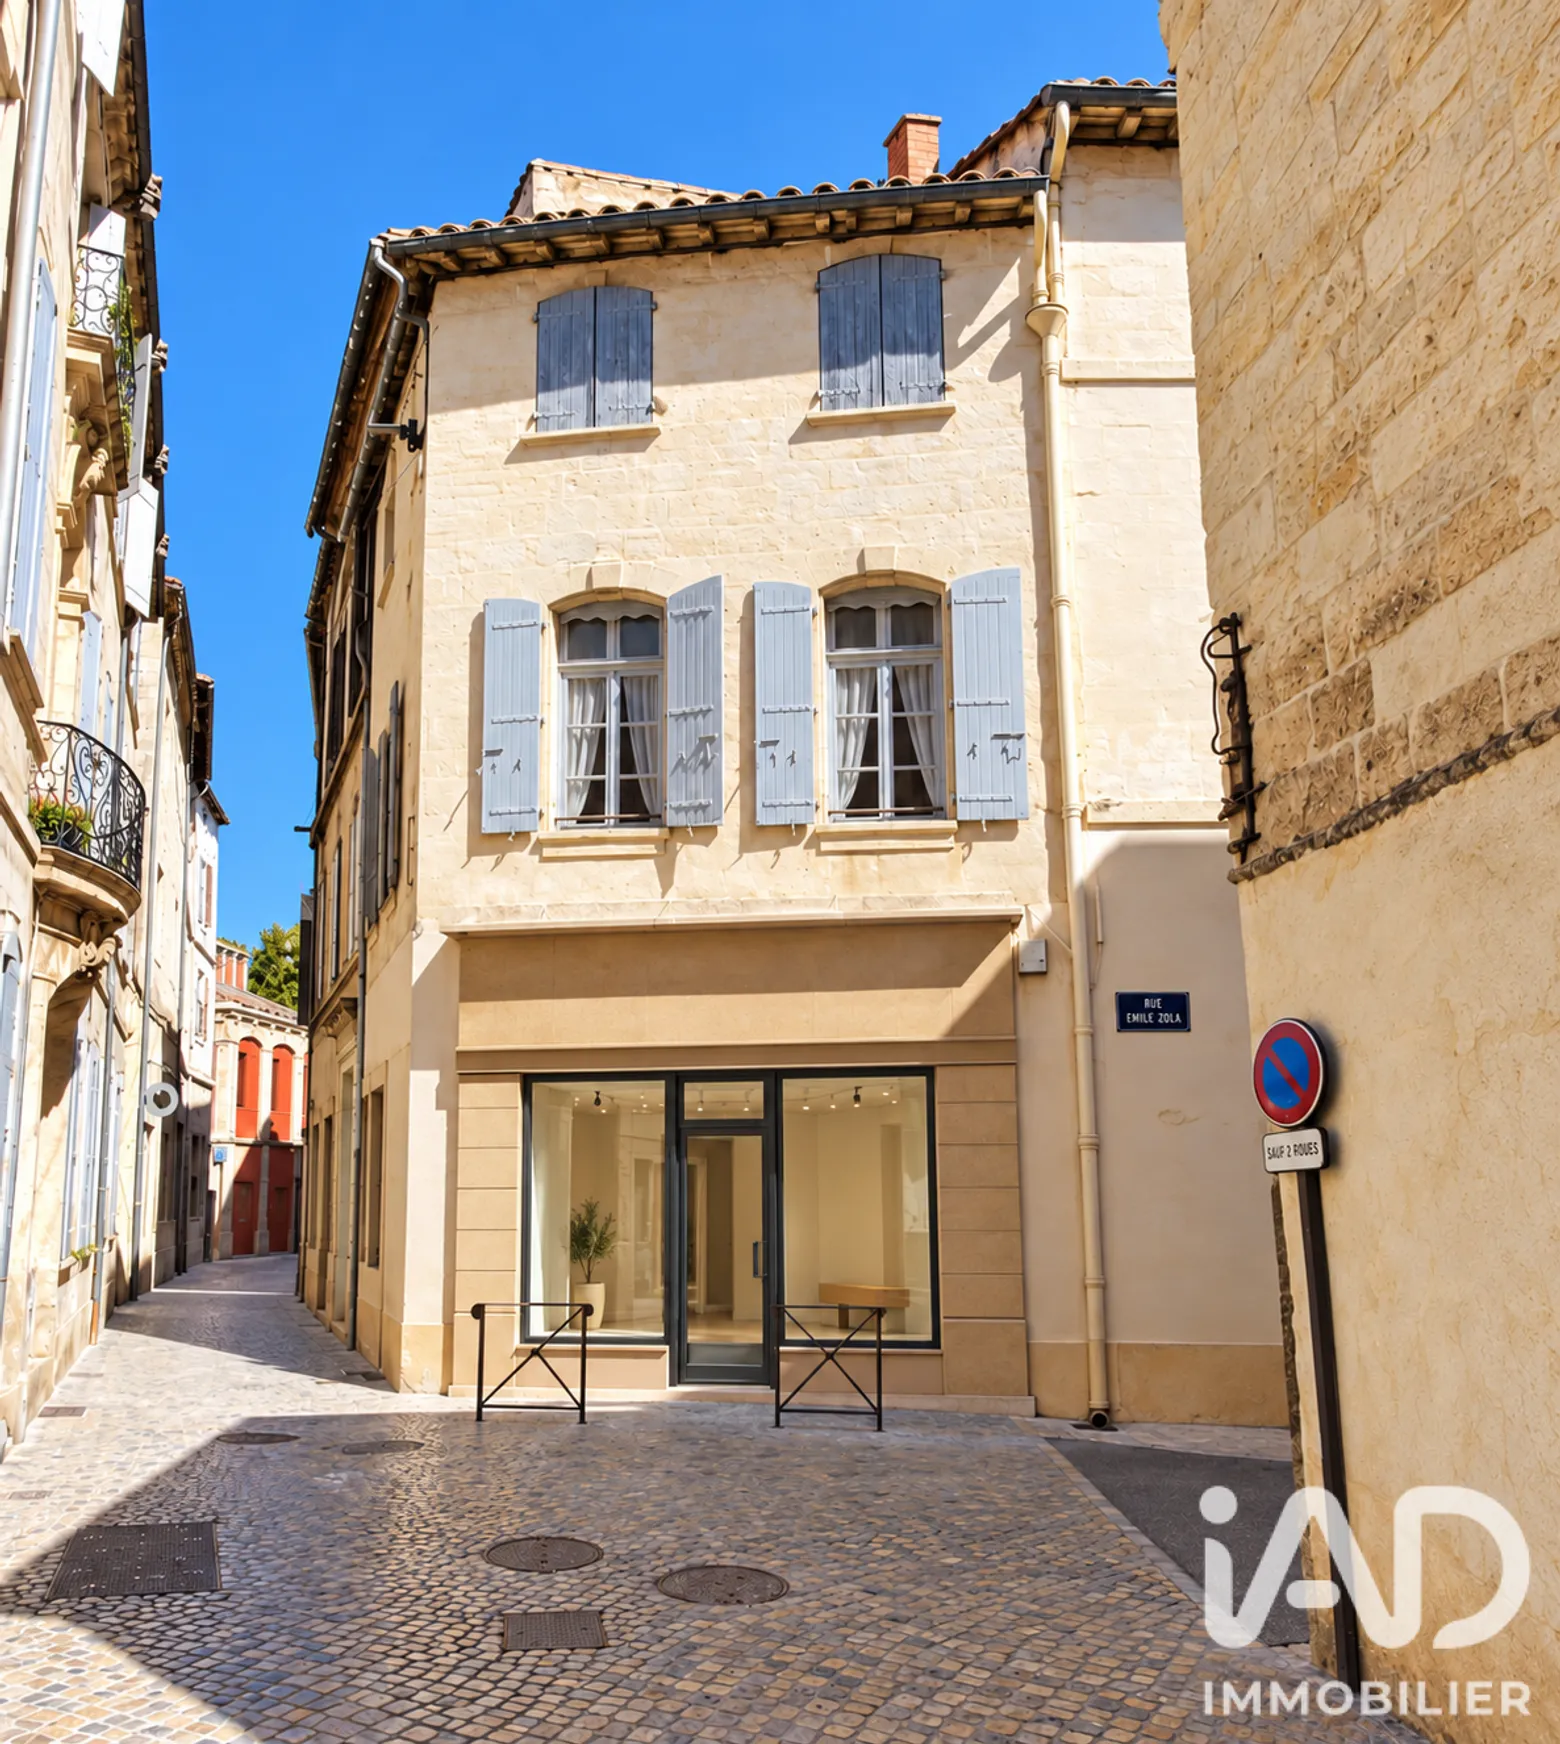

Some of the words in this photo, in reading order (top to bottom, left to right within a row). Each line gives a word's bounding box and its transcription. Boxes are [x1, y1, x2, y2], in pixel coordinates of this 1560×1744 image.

[1144, 998, 1162, 1009] RUE
[1126, 1012, 1154, 1024] EMILE
[1157, 1012, 1182, 1024] ZOLA
[1267, 1145, 1285, 1160] SAUF
[1286, 1144, 1292, 1158] 2
[1293, 1141, 1320, 1157] ROUES
